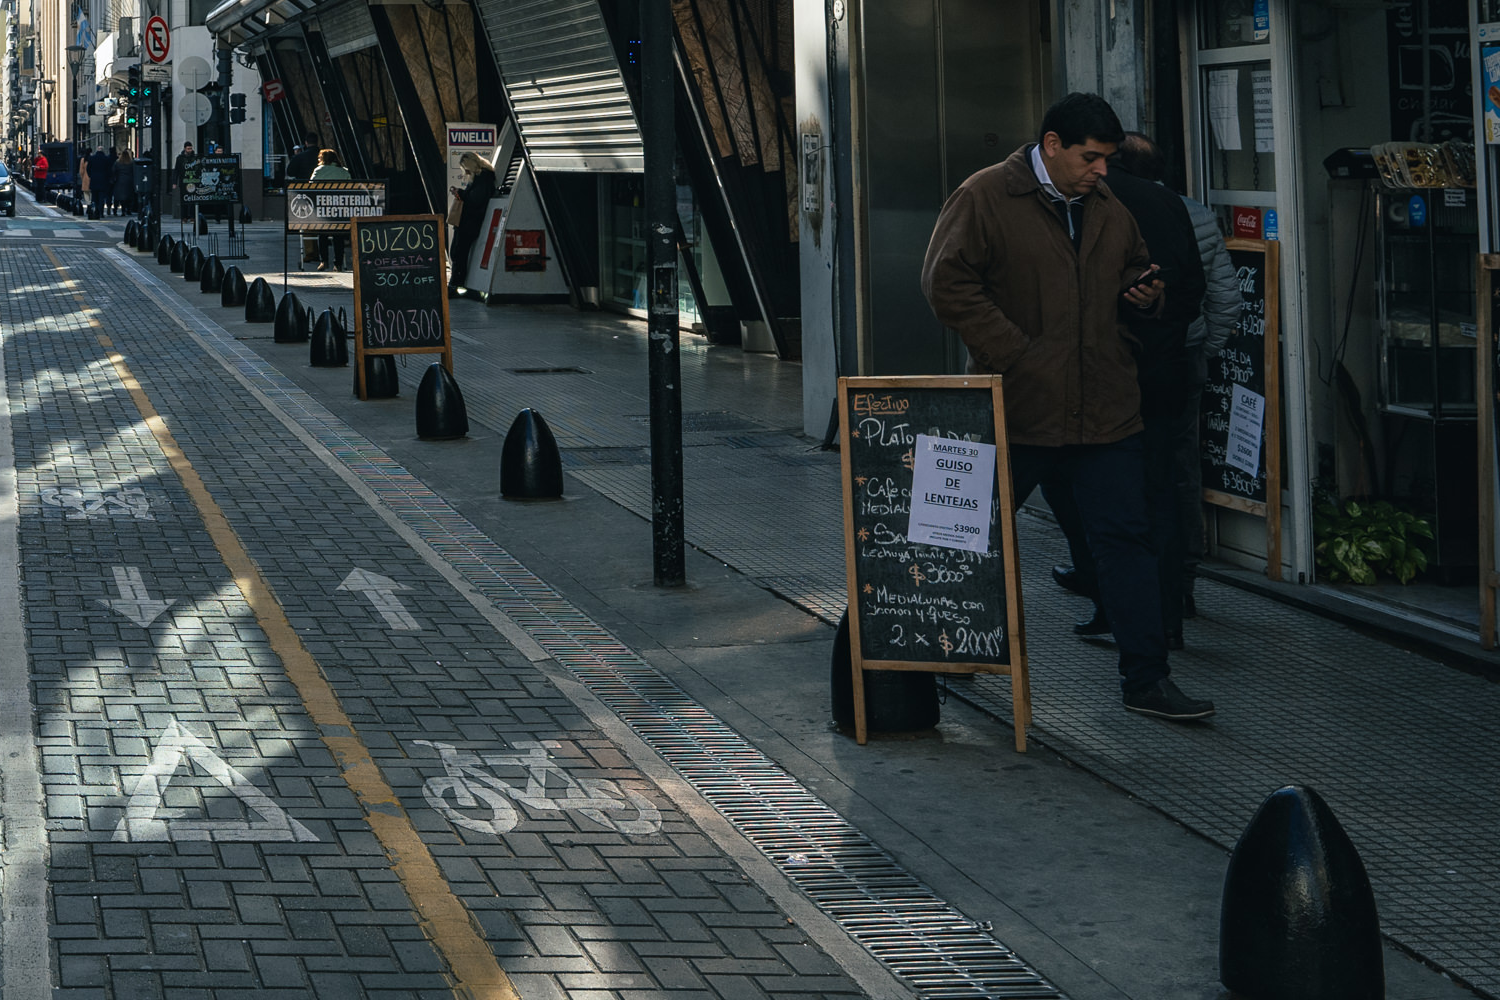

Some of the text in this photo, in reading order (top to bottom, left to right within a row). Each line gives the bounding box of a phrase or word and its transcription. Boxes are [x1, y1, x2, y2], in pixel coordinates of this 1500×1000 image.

[153, 27, 163, 51] E
[145, 116, 152, 125] 3
[450, 132, 493, 143] VINELLI
[316, 195, 379, 206] FERRETERIA Y
[316, 206, 383, 217] ELECTRICIDAD
[361, 224, 434, 253] BUZOS
[374, 255, 423, 266] OFERTA
[374, 272, 435, 286] 30% OFF
[373, 298, 441, 346] $20.300
[1241, 394, 1257, 409] CAFÉ
[934, 443, 978, 456] MARTES 30
[936, 459, 973, 472] GUISO
[946, 478, 960, 488] DE
[925, 493, 978, 509] LENTEJAS
[954, 523, 980, 535] $3900
[889, 624, 906, 647] 2
